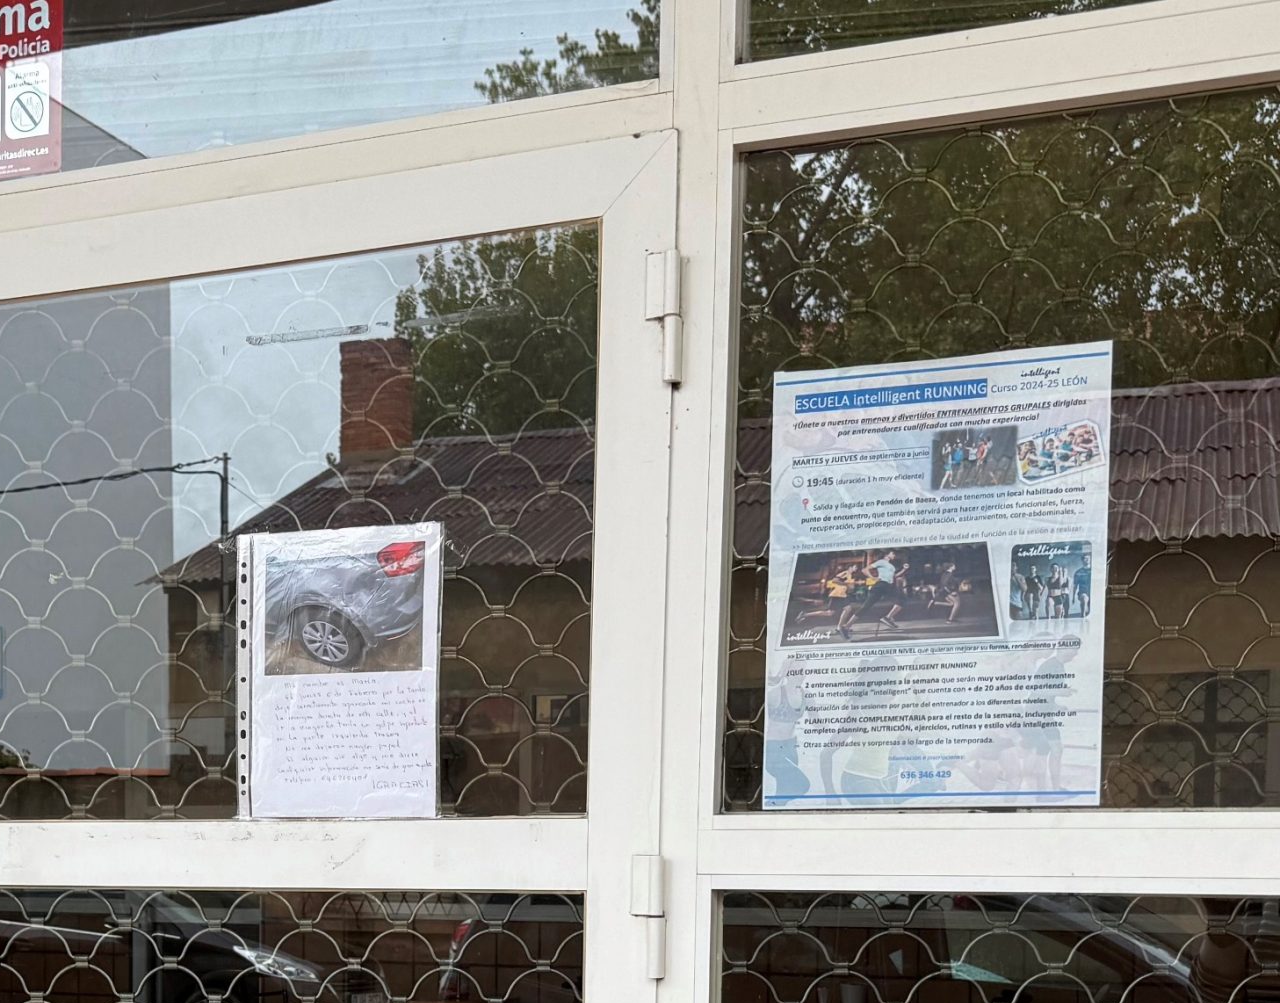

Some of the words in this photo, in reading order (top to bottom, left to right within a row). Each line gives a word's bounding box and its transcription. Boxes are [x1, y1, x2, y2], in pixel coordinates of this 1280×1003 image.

[0, 35, 50, 60] Policía
[796, 395, 849, 410] ESCUELA
[924, 383, 988, 399] RUNNING
[990, 381, 1017, 392] Curso
[1020, 378, 1059, 389] 2024-25
[1061, 374, 1087, 386] LEÓN
[827, 417, 858, 426] nuestros
[897, 411, 934, 420] divertidos
[936, 405, 1008, 417] ENTRENAMIENTOS
[1010, 401, 1051, 411] GRUPALES
[1052, 398, 1086, 409] dirigidos
[852, 424, 901, 434] entrenadores
[903, 420, 947, 430] cualificados
[964, 417, 990, 425] mucha
[992, 413, 1039, 425] experiencia!
[792, 457, 823, 466] MARTES
[831, 454, 857, 463] JUEVES
[869, 451, 905, 461] septiembre
[912, 449, 929, 458] junio
[1018, 545, 1071, 560] intelligent
[787, 629, 831, 644] intelligent
[786, 668, 803, 676] ¿QUÉ
[857, 665, 895, 673] DEPORTIVO
[897, 663, 938, 671] INTELLIGENT
[810, 679, 865, 688] entrenamientos
[867, 678, 896, 687] grupales
[994, 673, 1026, 681] variados
[1033, 671, 1075, 679] motivantes
[858, 714, 926, 722] COMPLEMENTARIA
[1025, 710, 1065, 719] incluyendo
[804, 726, 835, 735] completo
[837, 725, 869, 734] planning,
[870, 723, 912, 733] NUTRICIÓN,
[914, 723, 949, 732] ejercicios,
[1022, 720, 1064, 729] inteligente.
[918, 770, 933, 778] 346
[935, 770, 951, 778] 429
